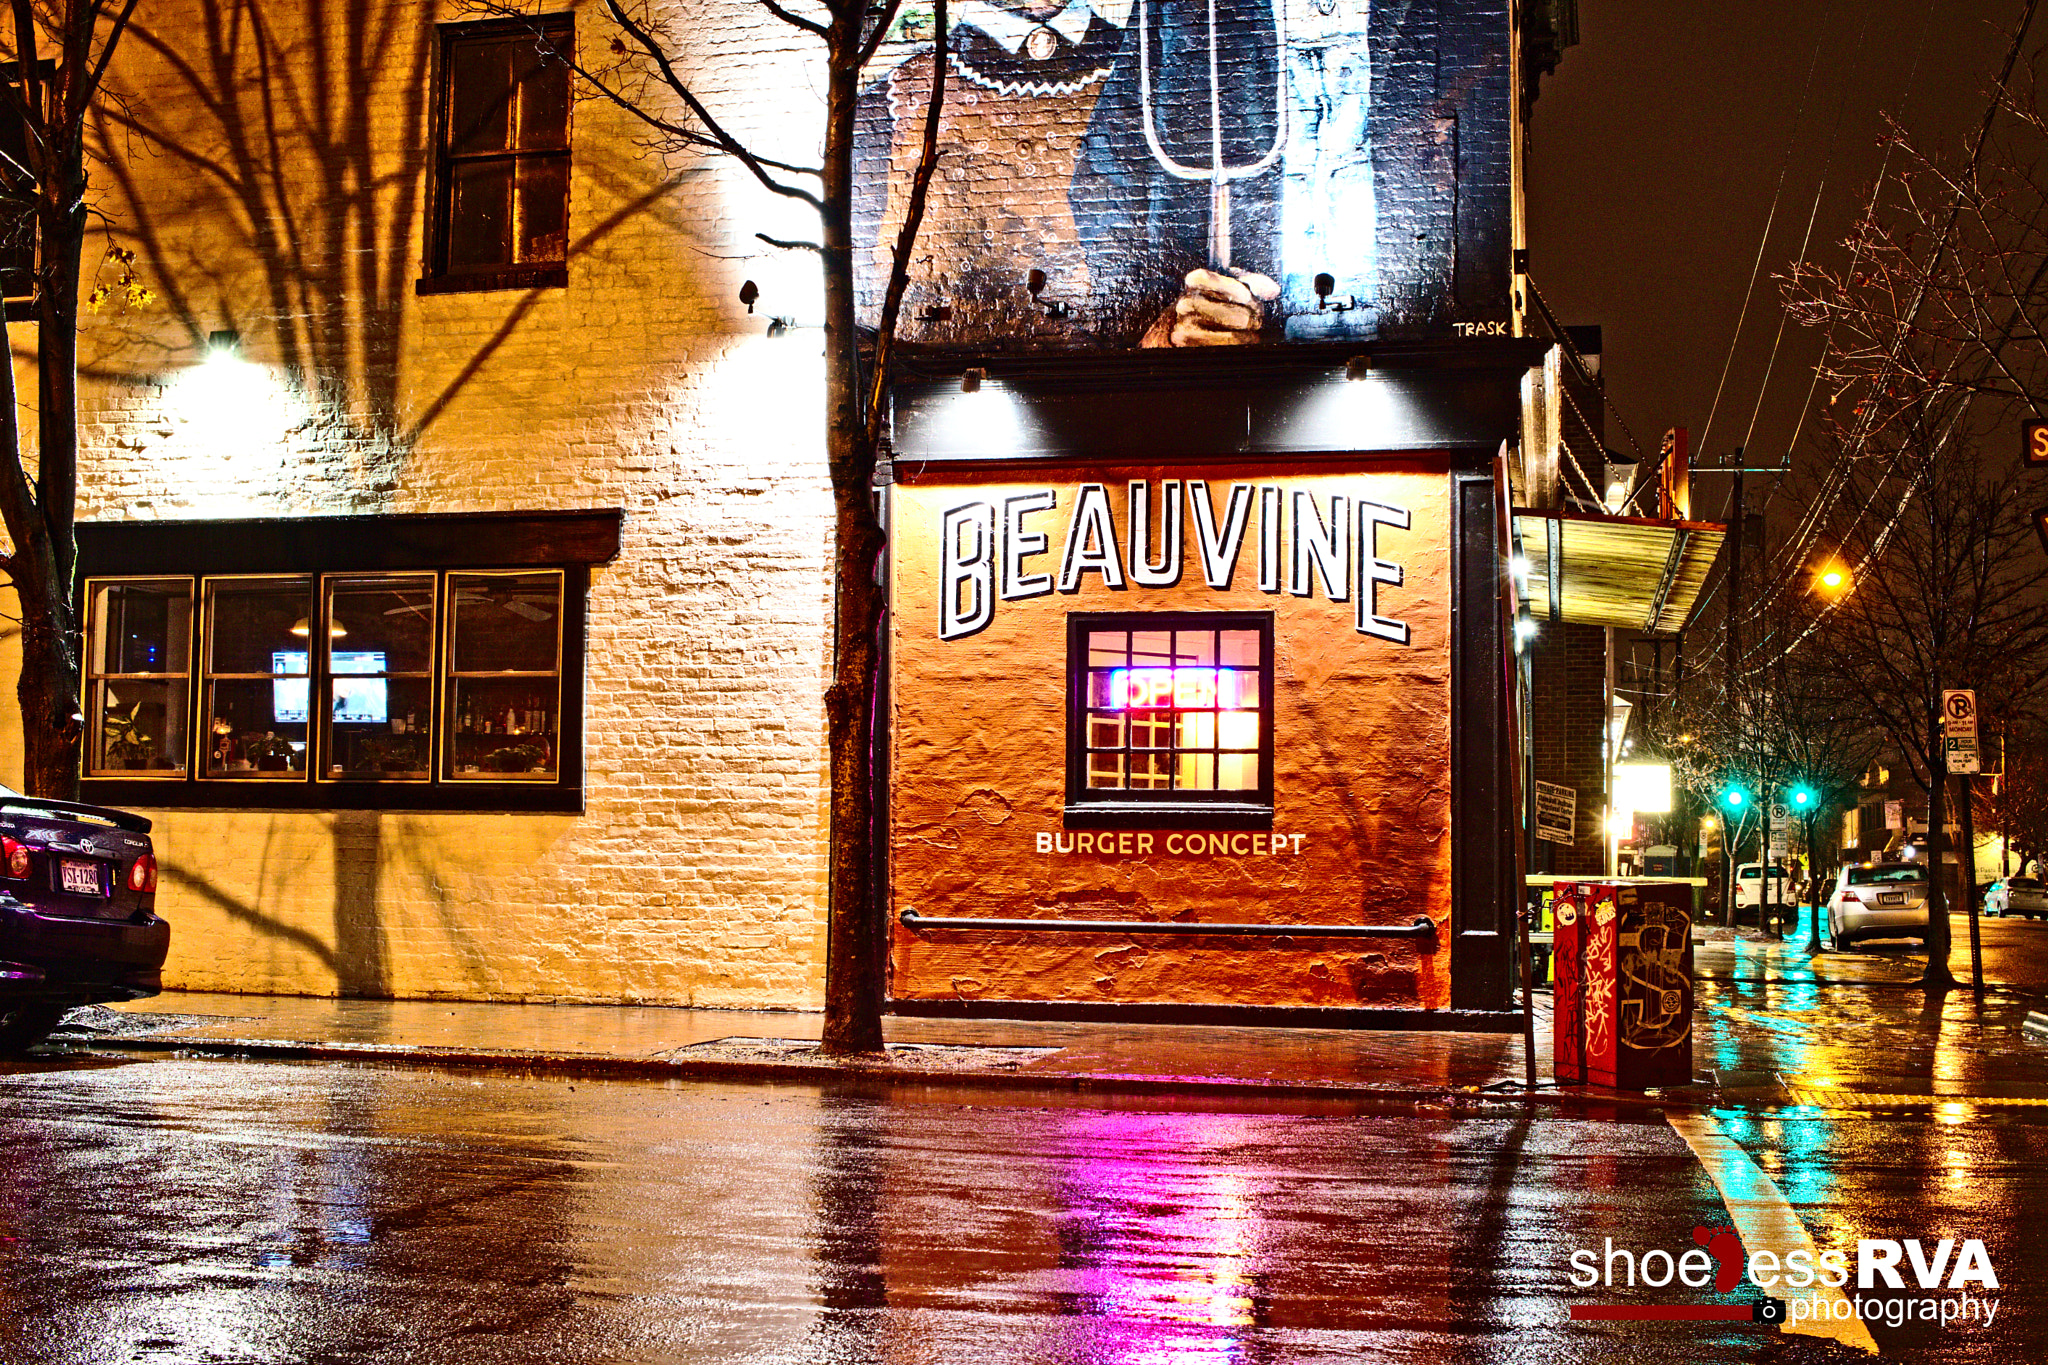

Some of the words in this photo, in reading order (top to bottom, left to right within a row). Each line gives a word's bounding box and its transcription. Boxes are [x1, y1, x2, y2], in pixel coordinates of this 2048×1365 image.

[1452, 320, 1507, 337] TRASK
[938, 479, 1411, 643] BEAUVINE
[1949, 739, 1956, 749] 2
[1036, 833, 1154, 855] BURGER
[1166, 833, 1306, 855] CONCEPT
